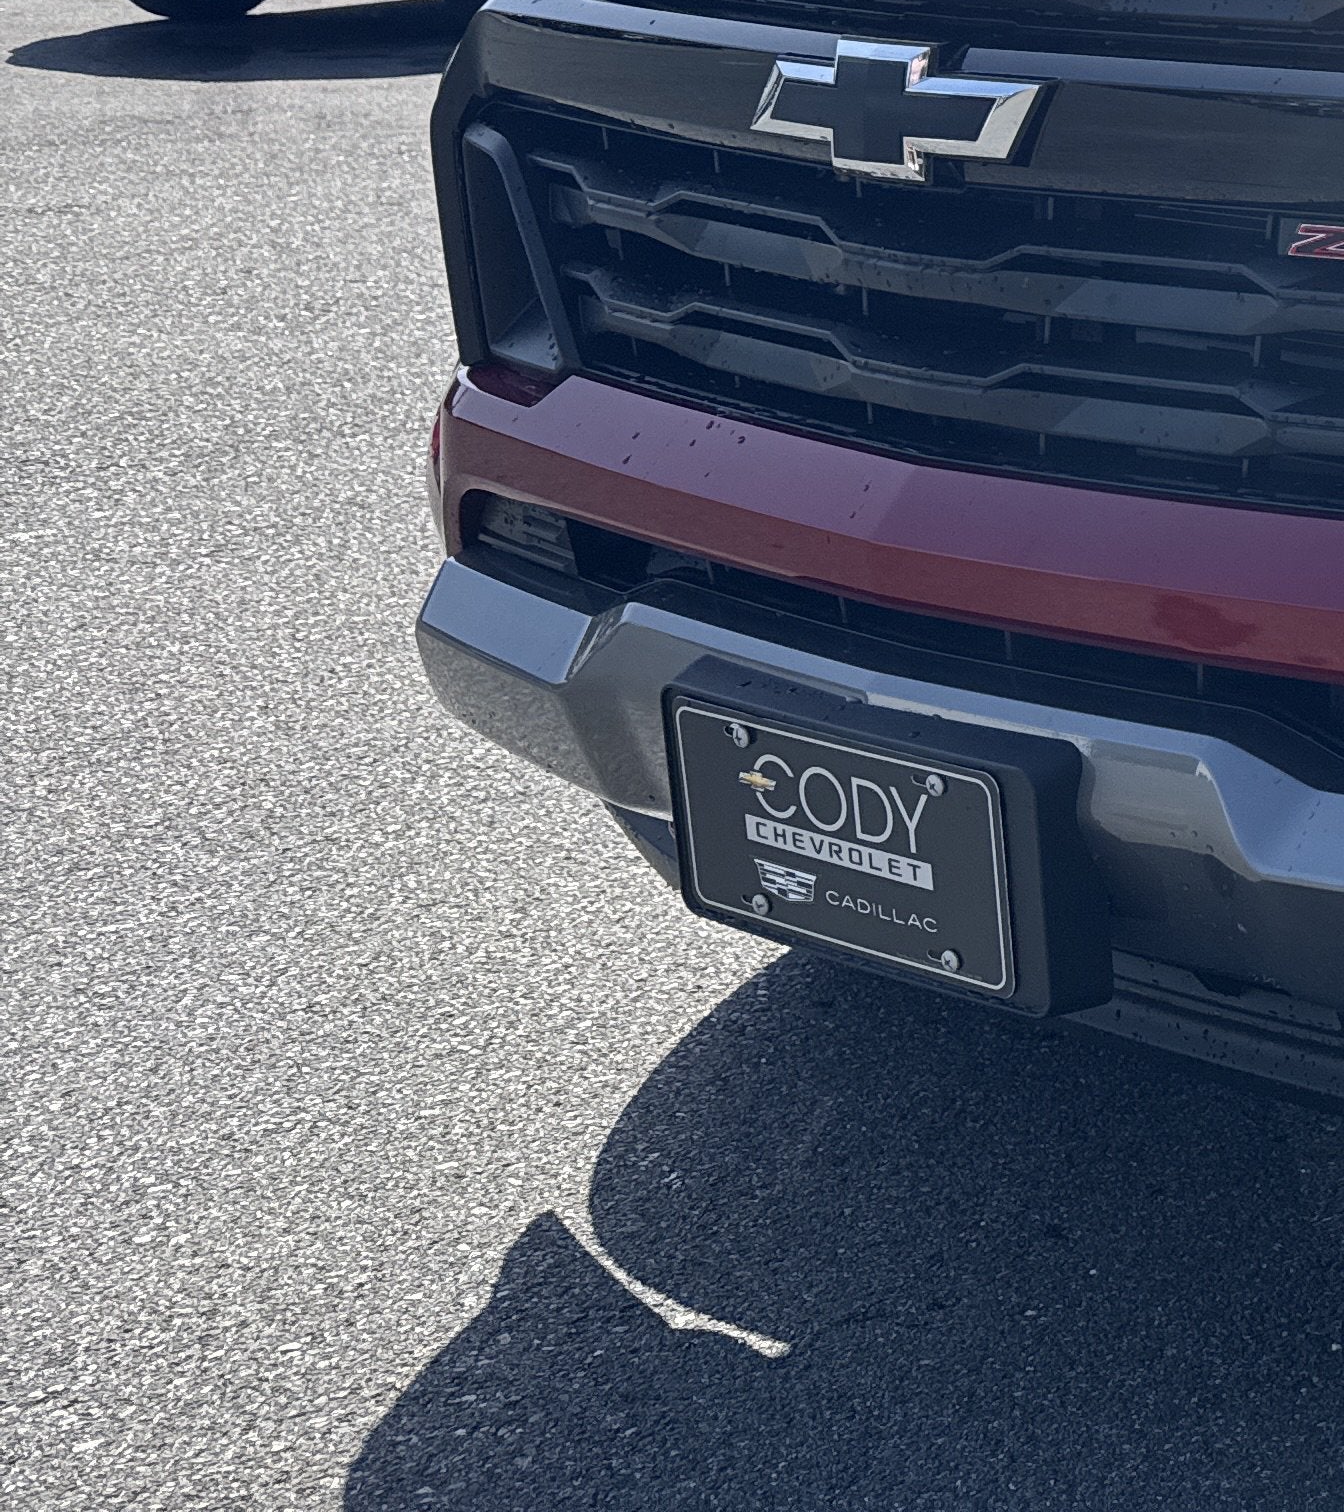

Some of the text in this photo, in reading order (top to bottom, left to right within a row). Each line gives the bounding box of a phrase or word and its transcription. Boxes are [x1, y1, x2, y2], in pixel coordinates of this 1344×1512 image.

[748, 754, 928, 854] CODY
[754, 821, 923, 882] CHEVROLET
[825, 890, 938, 933] CADILLAC
